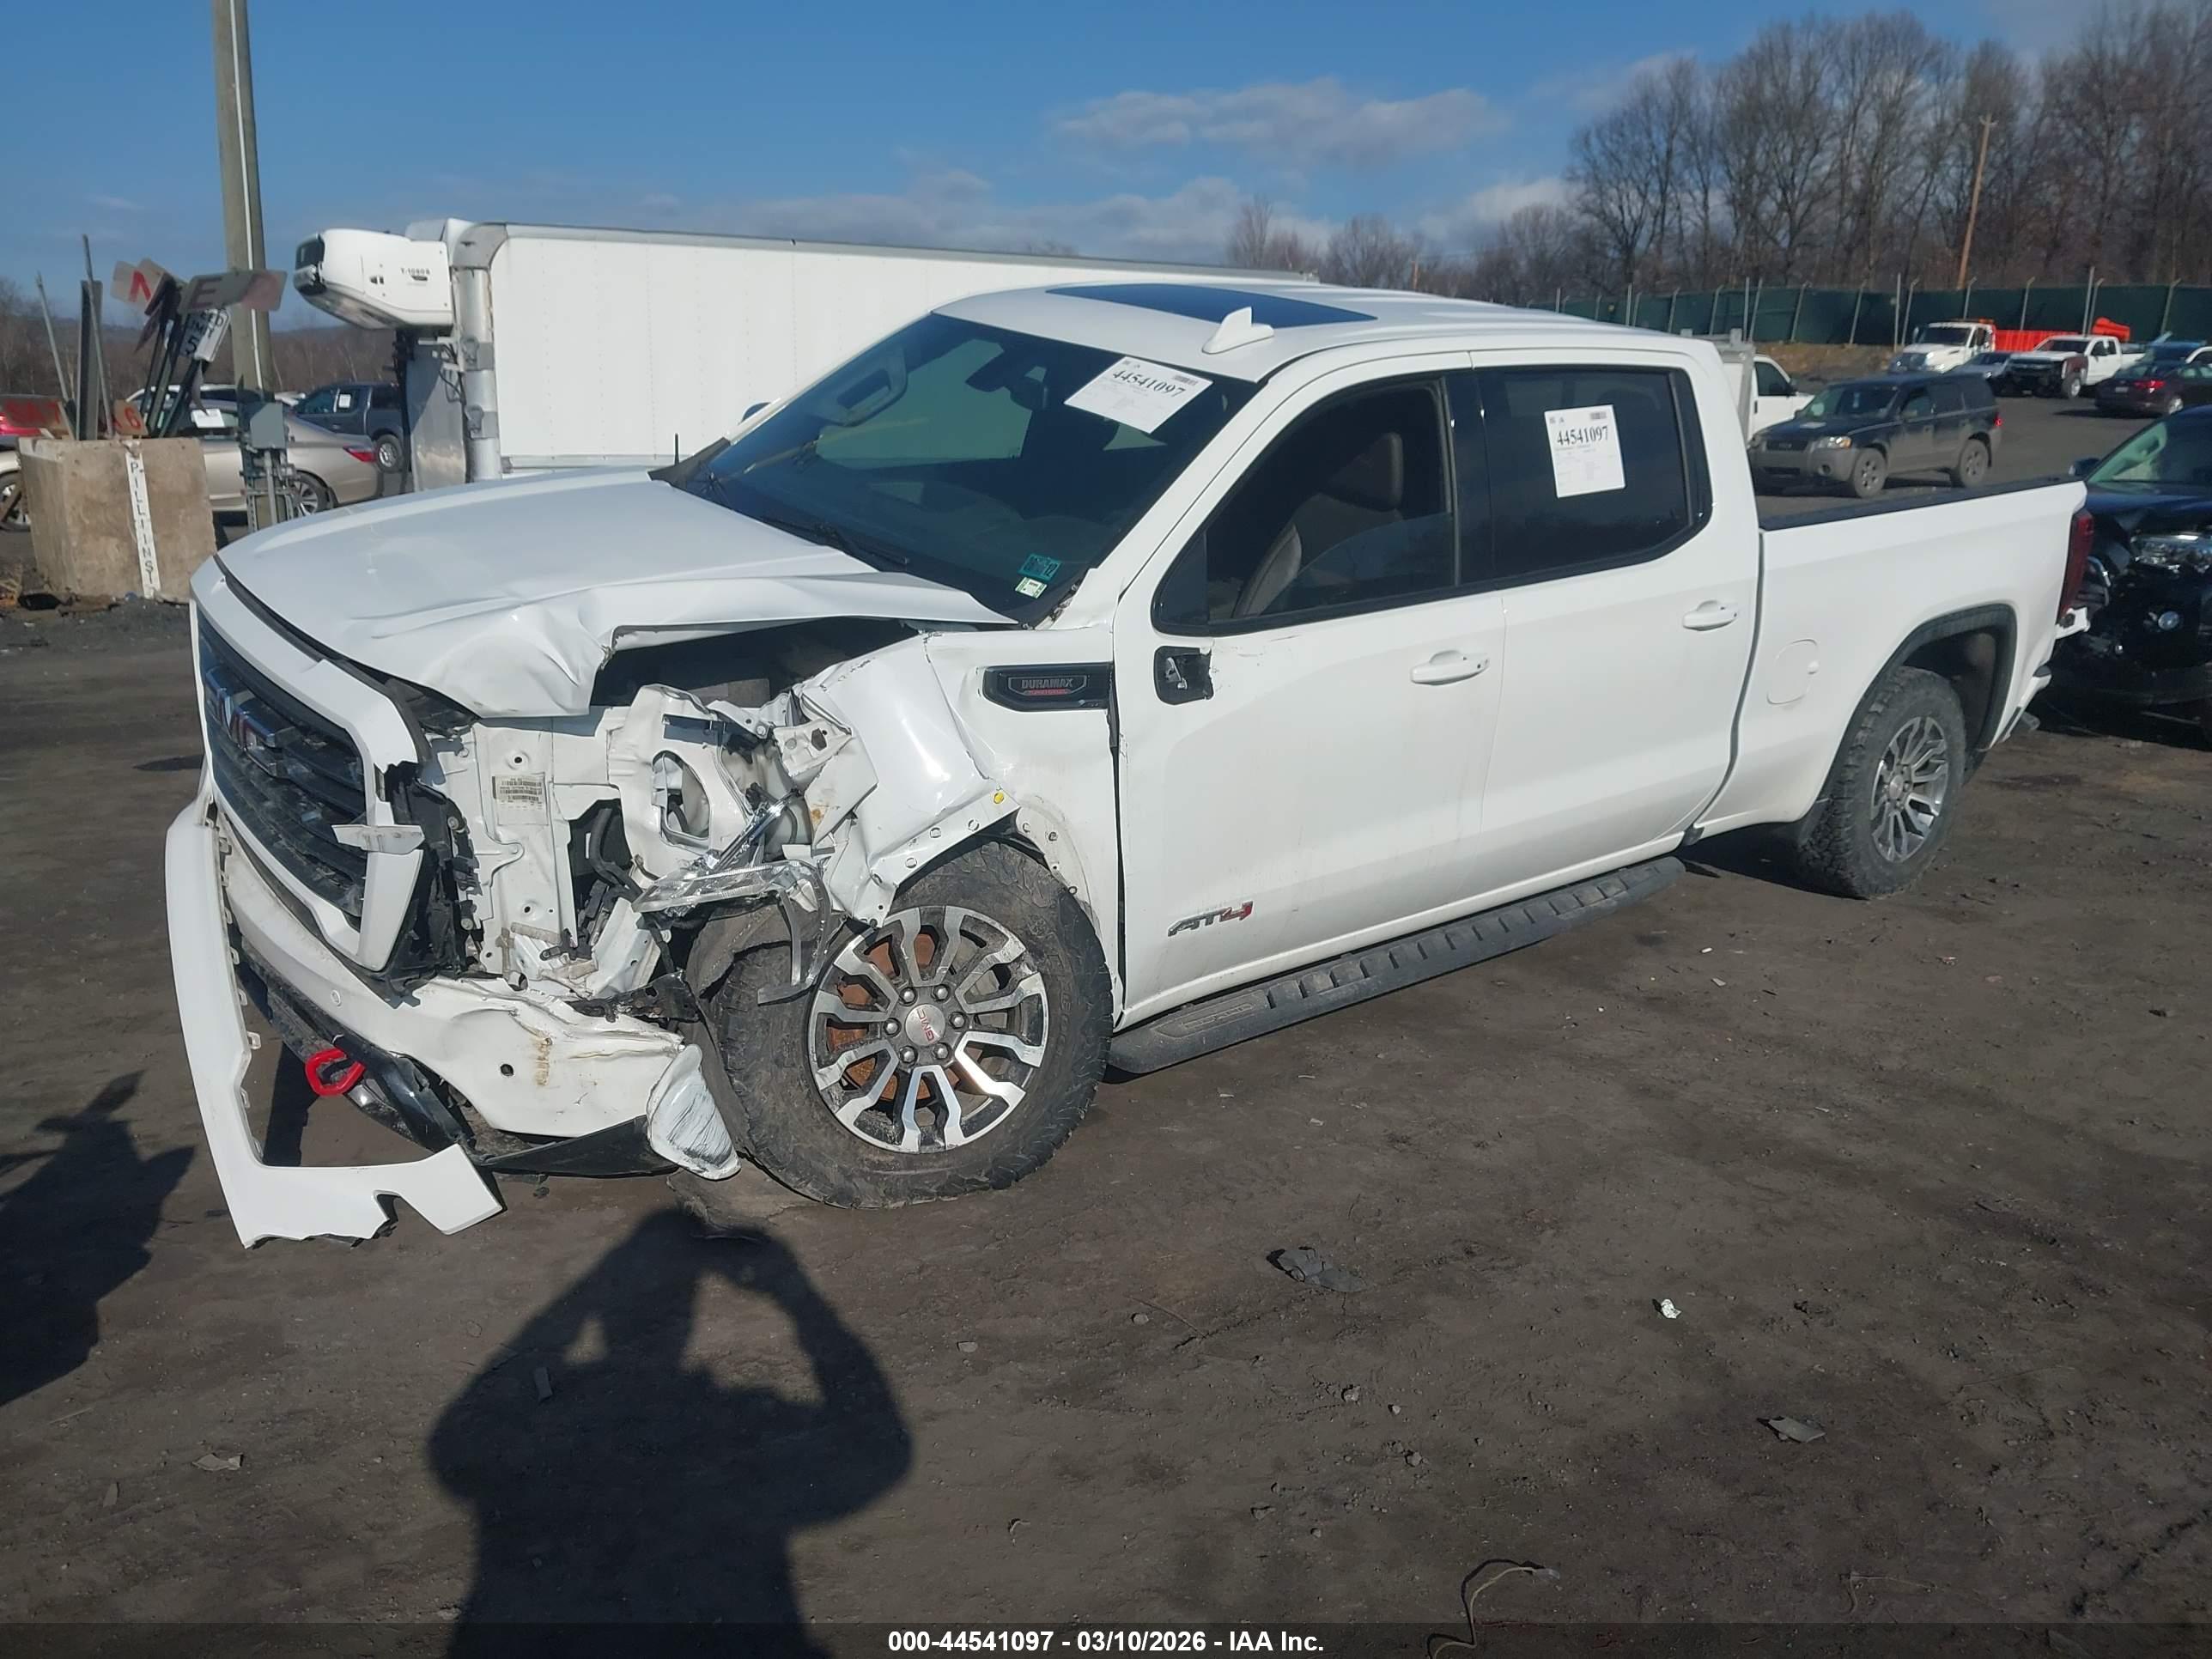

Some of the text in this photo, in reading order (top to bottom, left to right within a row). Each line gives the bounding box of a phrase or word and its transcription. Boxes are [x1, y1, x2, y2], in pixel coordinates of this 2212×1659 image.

[1112, 370, 1186, 398] 44541097
[1557, 425, 1608, 446] 44541097
[1021, 678, 1074, 689] DURAMAX
[1167, 900, 1254, 937] AT4
[916, 1008, 935, 1042] GMC
